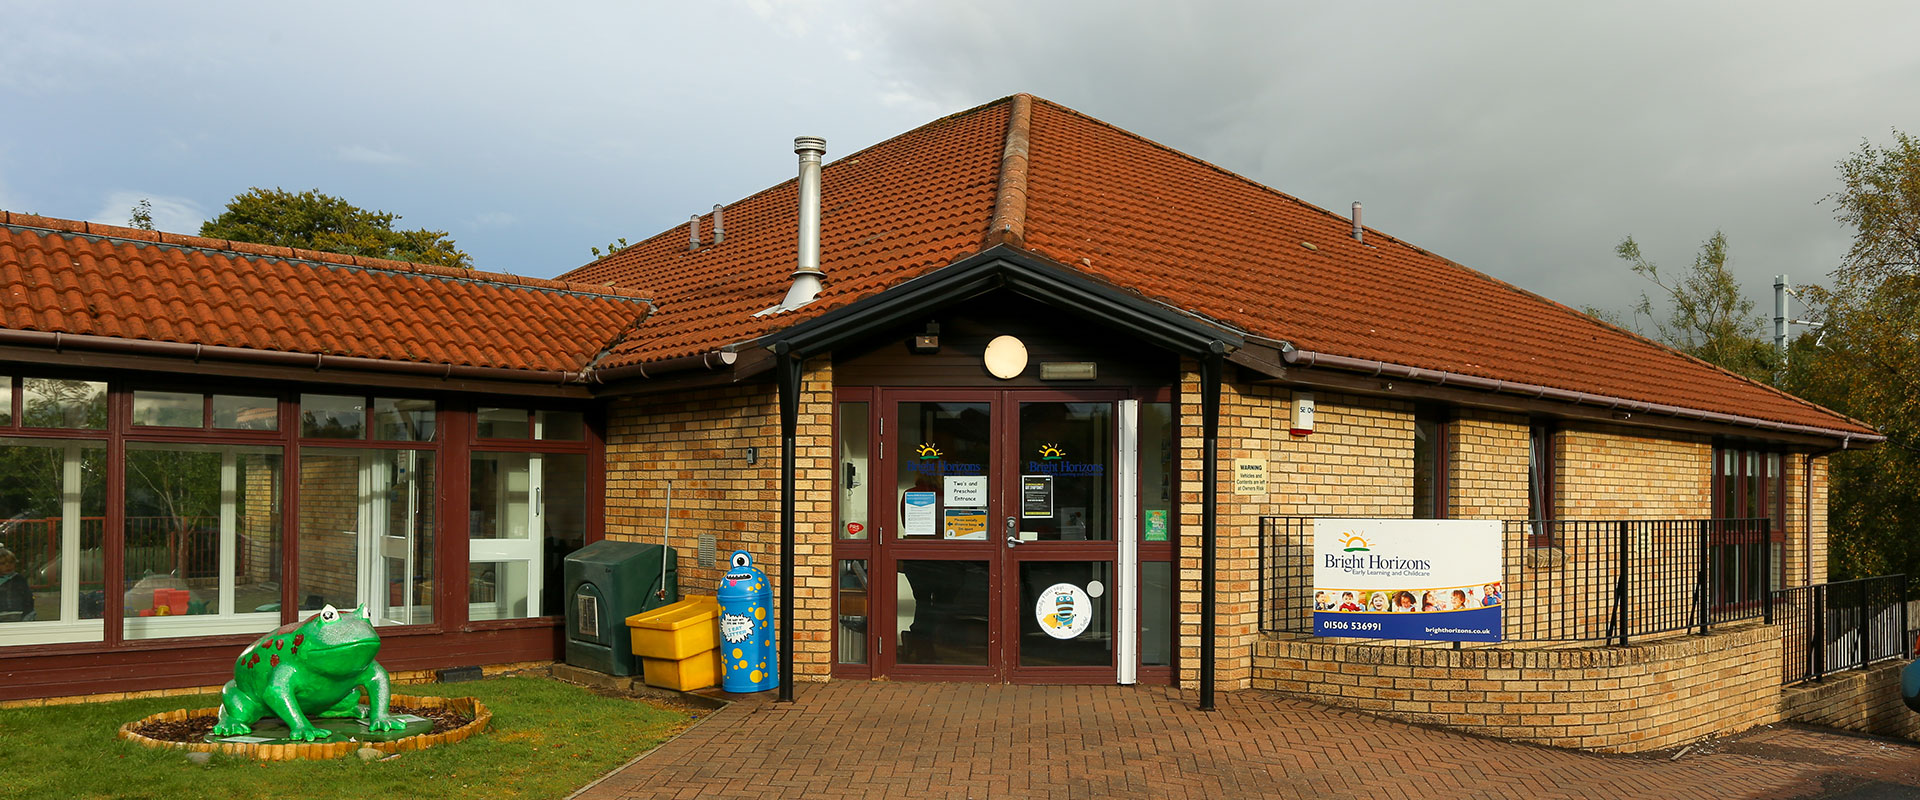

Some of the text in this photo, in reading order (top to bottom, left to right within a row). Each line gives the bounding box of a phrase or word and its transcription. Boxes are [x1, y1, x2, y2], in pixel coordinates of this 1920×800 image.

[907, 461, 981, 474] Bright Horizons
[1029, 461, 1104, 474] Bright Horizons
[1325, 554, 1431, 573] Bright Horizons
[1367, 569, 1391, 577] Learning
[1323, 620, 1382, 631] 01506 536991
[1425, 626, 1491, 635] brighthorizons.co.uk
